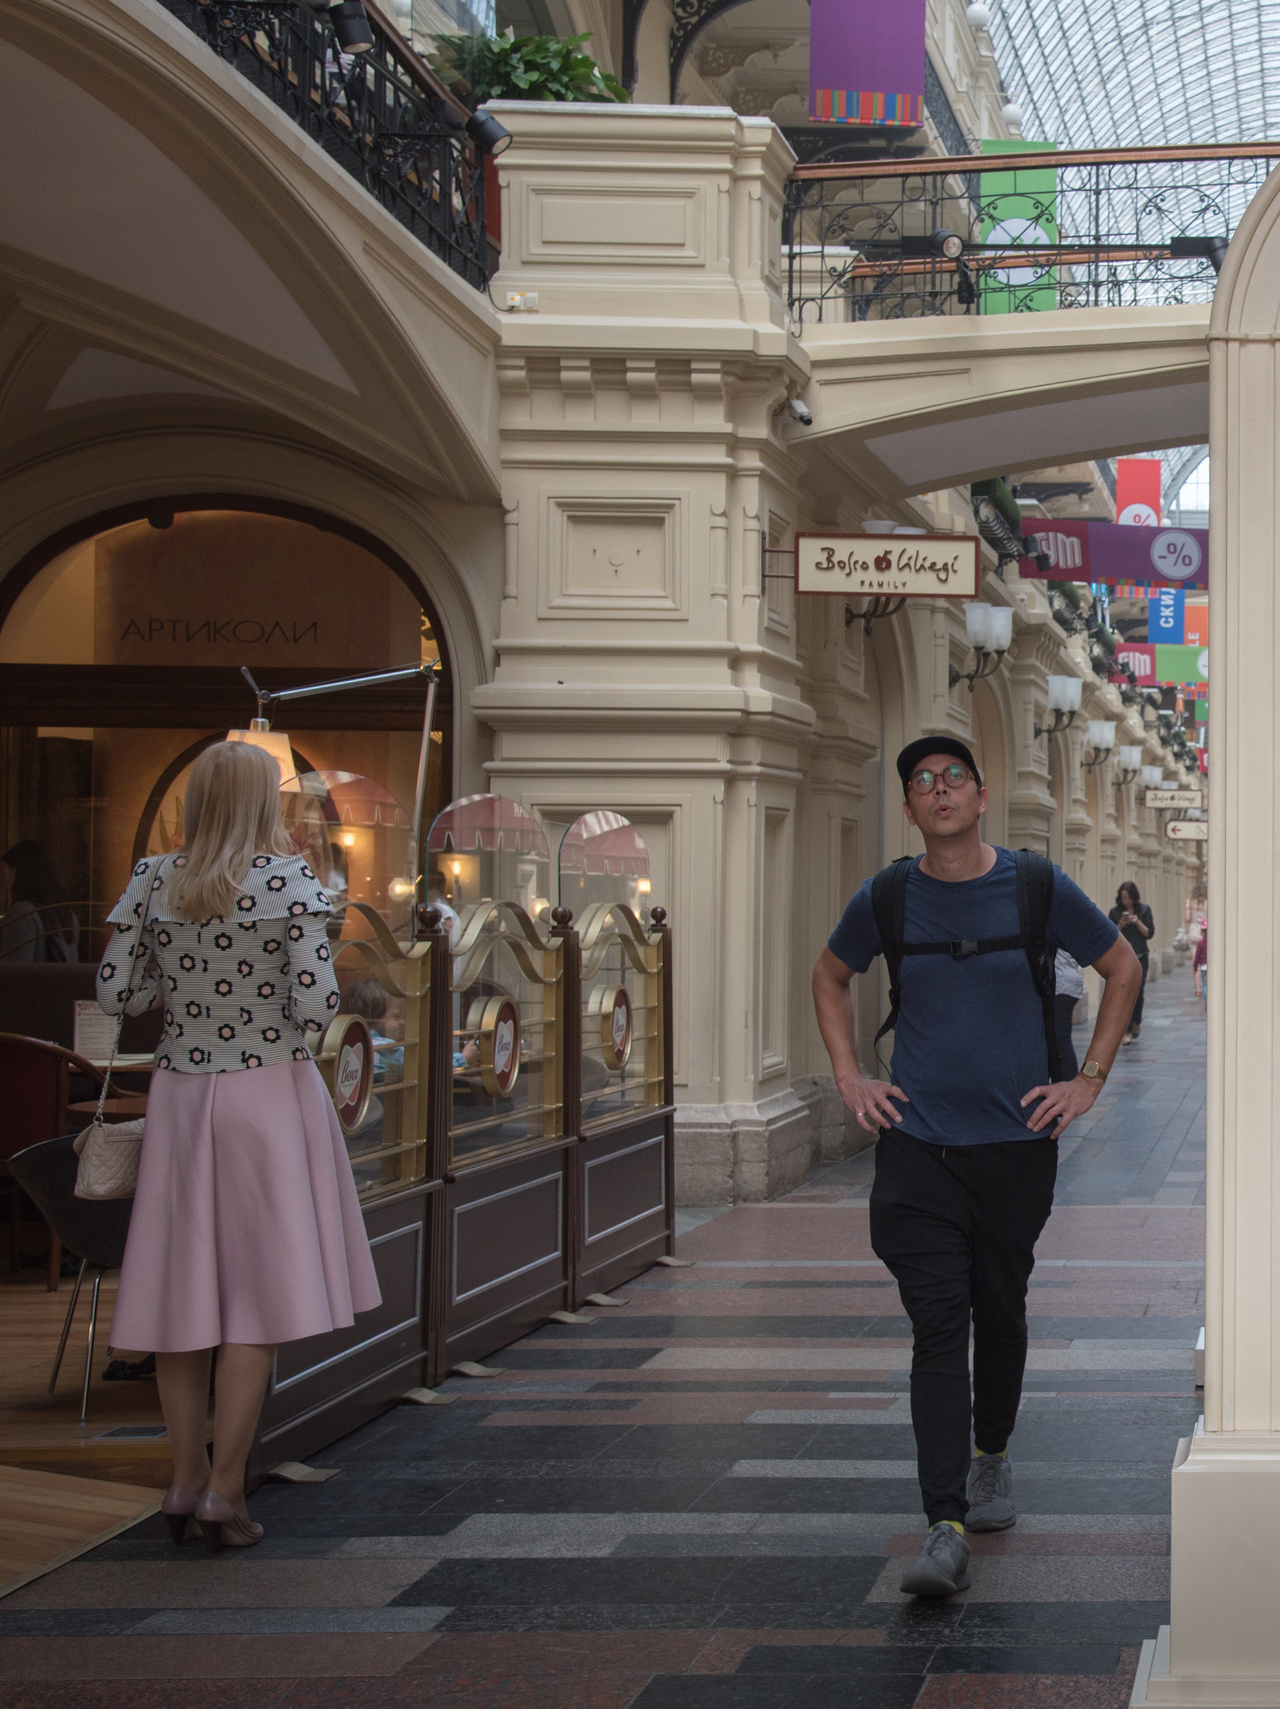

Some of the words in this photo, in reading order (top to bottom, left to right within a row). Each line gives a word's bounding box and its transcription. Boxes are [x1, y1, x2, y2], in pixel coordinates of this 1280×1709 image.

[815, 546, 870, 577] Bosco
[860, 580, 908, 589] FAMILY
[119, 618, 318, 644] АРТИКОЛИ
